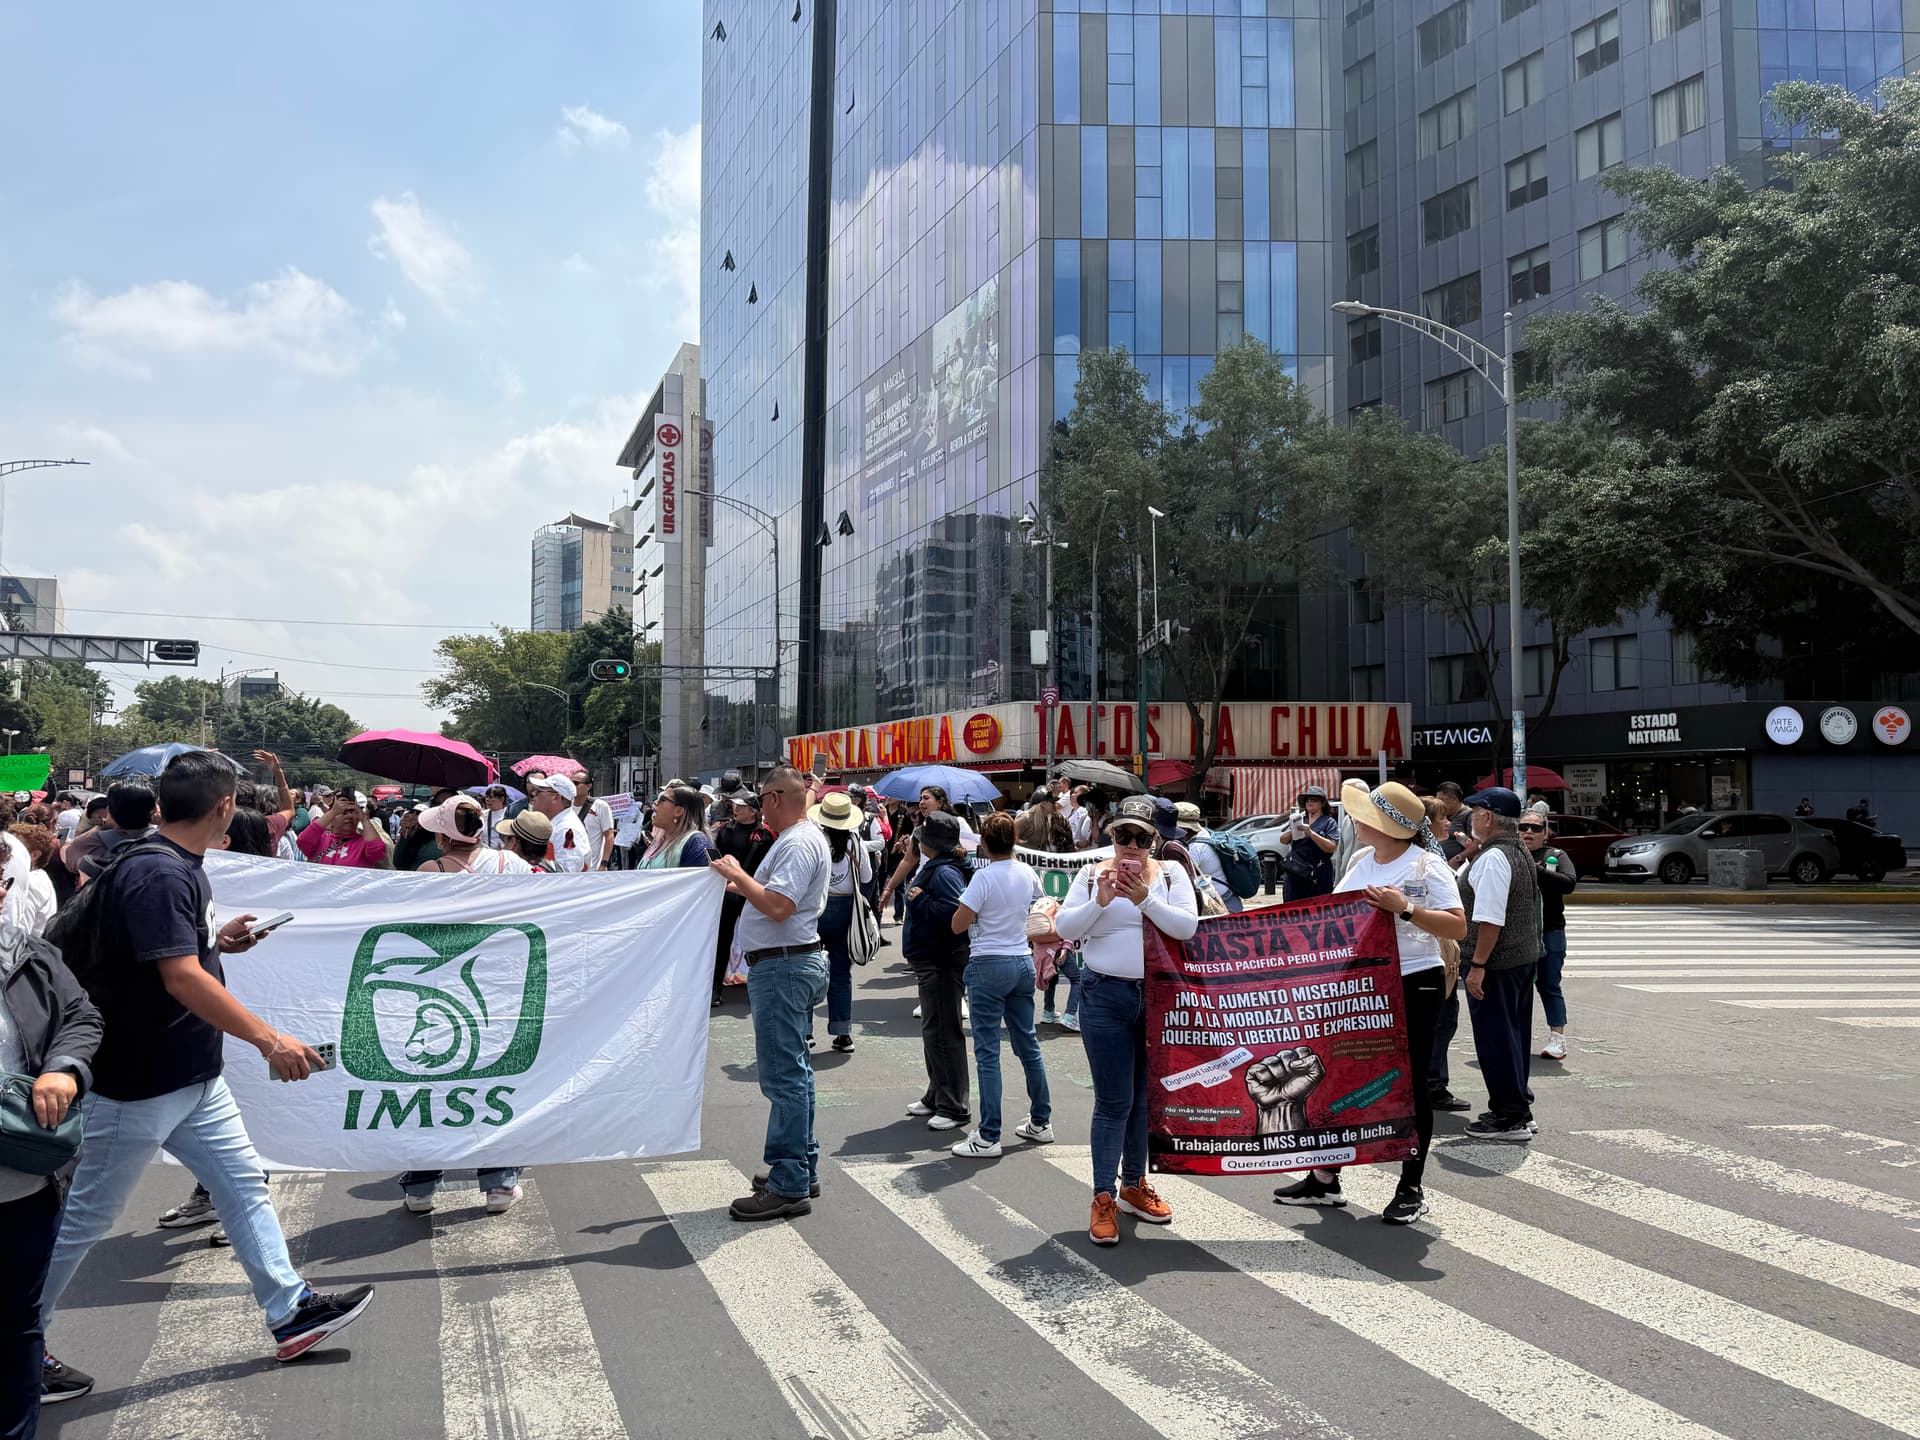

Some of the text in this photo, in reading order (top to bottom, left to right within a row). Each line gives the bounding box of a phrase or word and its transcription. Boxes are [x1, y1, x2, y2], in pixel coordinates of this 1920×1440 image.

[663, 451, 675, 535] URGENCIAS
[970, 718, 992, 728] TORTILLAS
[973, 729, 990, 738] HECHAS
[1034, 704, 1160, 756] TACOS
[1271, 705, 1404, 758] CHULA
[1631, 712, 1678, 729] ESTADO
[1771, 718, 1793, 726] ARTE
[845, 728, 873, 769] LA
[877, 715, 956, 766] CHULA
[1411, 727, 1493, 747] RTEMIGA
[1628, 728, 1682, 745] NATURAL
[1298, 917, 1358, 951] YA!
[1183, 947, 1359, 974] PROTESTA PACIFICA PERO FIRME.
[1175, 976, 1375, 1010] ¡NO AL AUMENTO MISERABLE!
[1164, 994, 1390, 1029] ¡NO A LA MORDAZA ESTATUTARIA!
[1161, 1013, 1395, 1046] ¡QUEREMOS LIBERTAD DE EXPRESION!
[1165, 1050, 1248, 1087] Dignidad laboral para
[1203, 1073, 1228, 1086] todos
[343, 1085, 517, 1130] IMSS
[1196, 1107, 1241, 1115] indiferencia
[1172, 1124, 1397, 1154] Trabajadores IMSS en pie de lucha.
[1227, 1152, 1351, 1169] Querétaro Convoca
